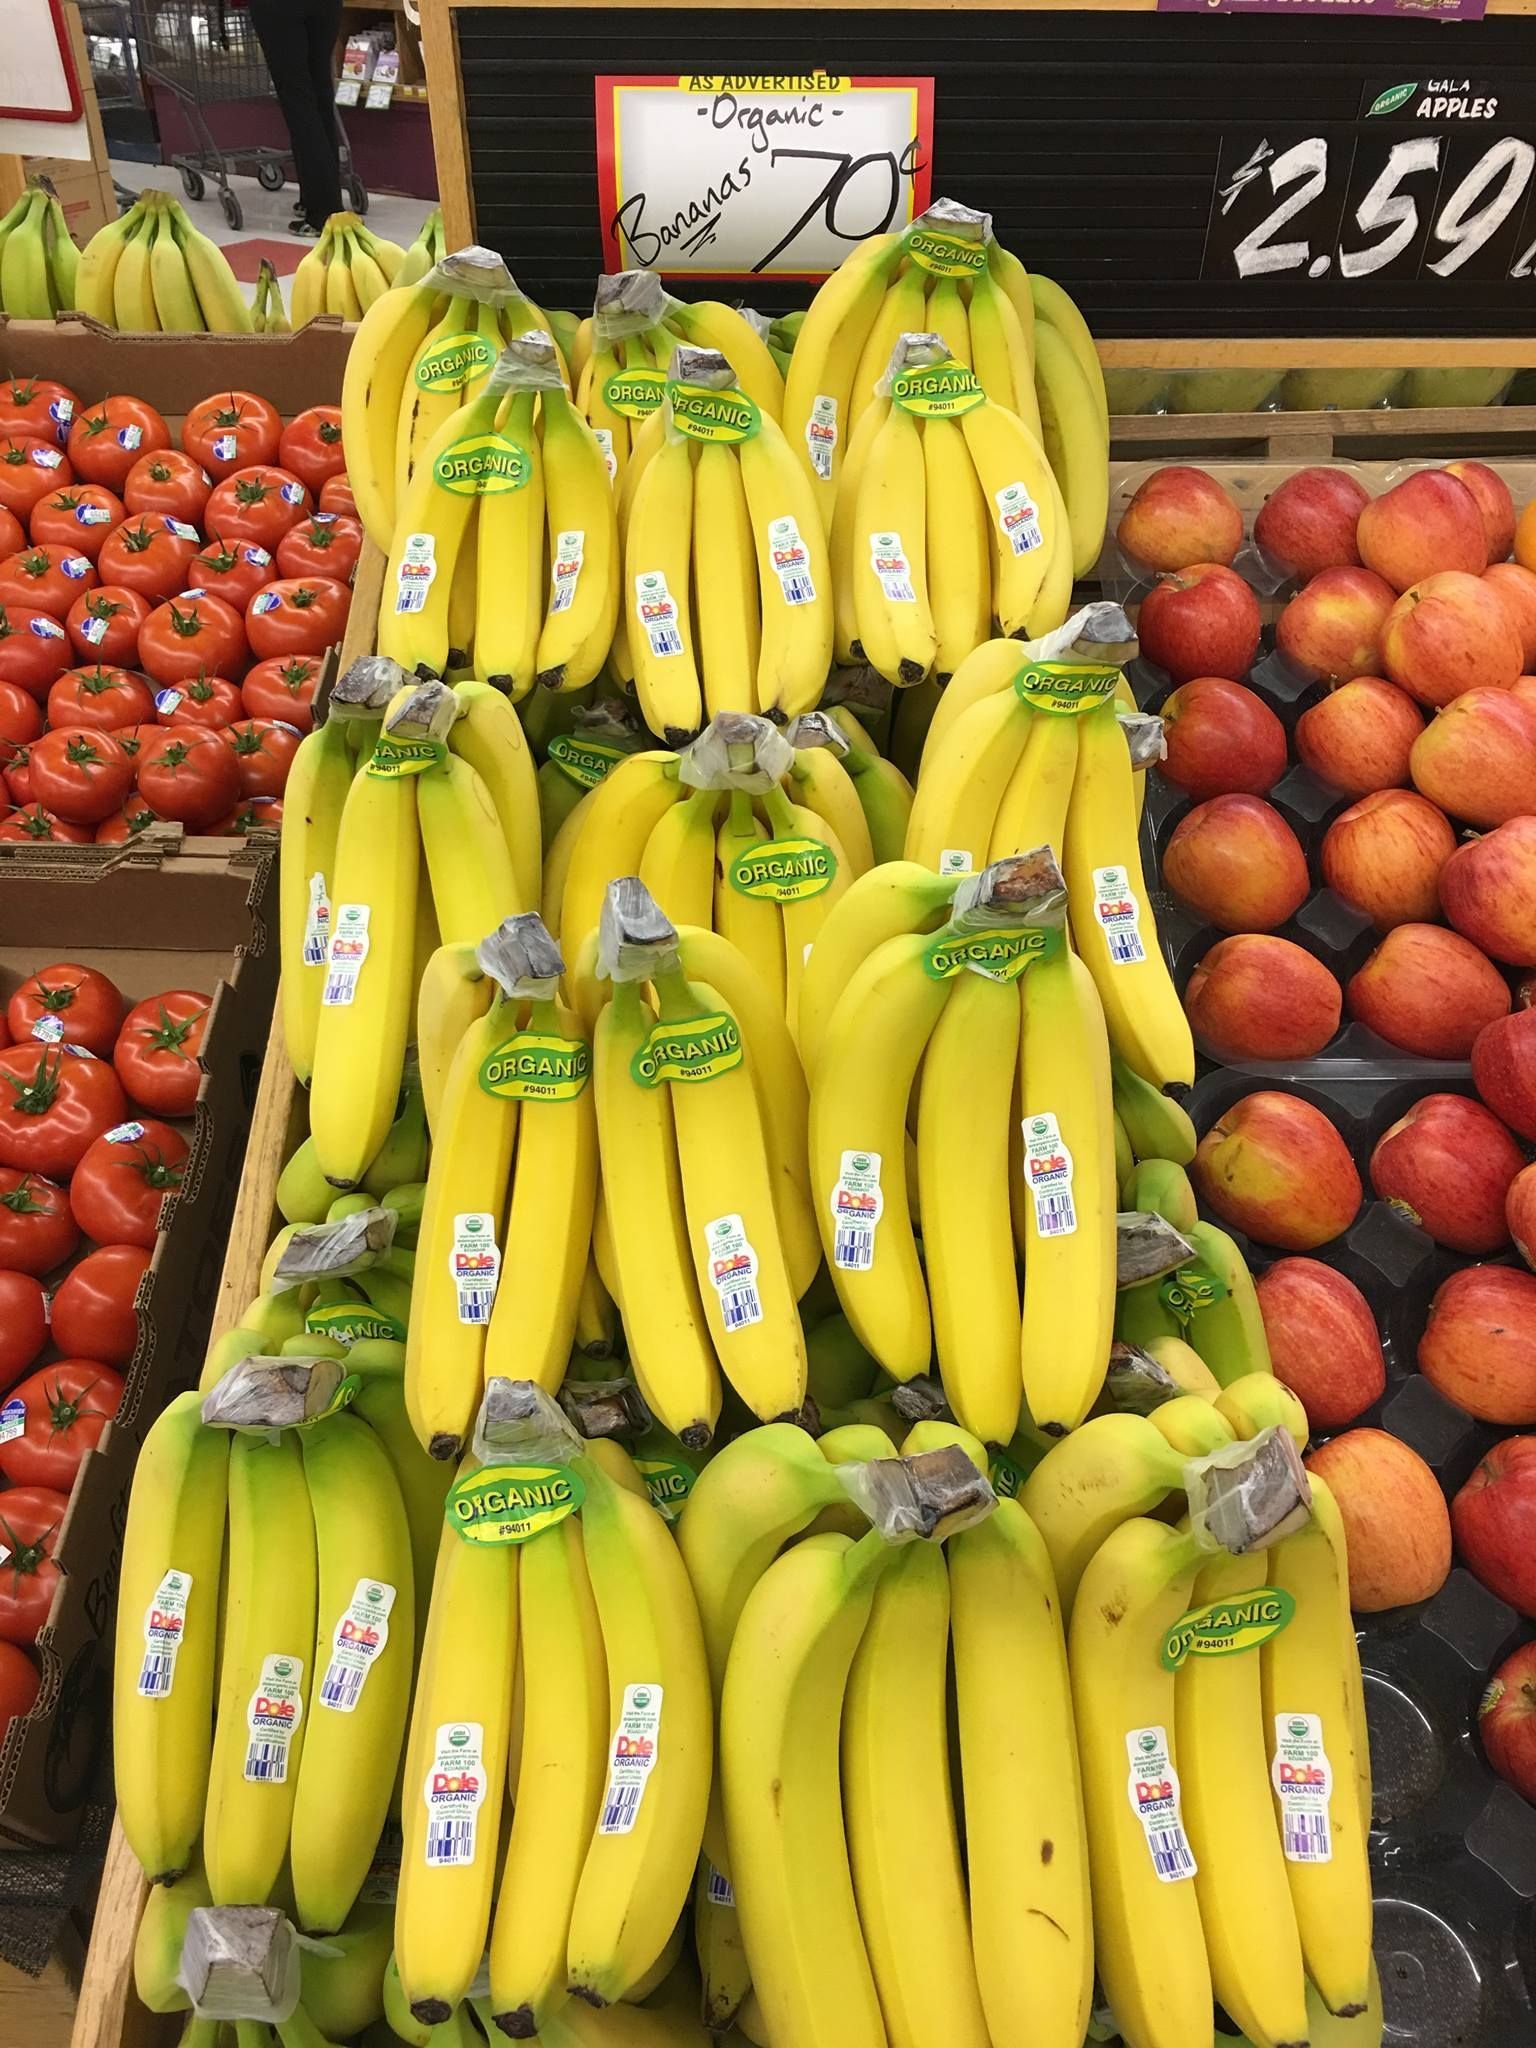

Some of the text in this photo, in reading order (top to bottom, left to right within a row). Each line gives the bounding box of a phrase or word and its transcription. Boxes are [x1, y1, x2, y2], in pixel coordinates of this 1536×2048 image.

[688, 75, 841, 90] AS ADVERTISED
[1427, 79, 1471, 93] GALA
[1373, 87, 1409, 113] ORGANIC
[1416, 97, 1499, 120] APPLES
[610, 156, 751, 267] Bananas
[908, 234, 985, 268] ORGANIC
[928, 262, 952, 274] #94011
[418, 345, 488, 382] ORGANIC
[608, 385, 665, 402] ORGAN
[893, 375, 983, 398] ORGANIC
[670, 387, 753, 429] ORGANIC
[928, 401, 955, 412] #94011
[686, 423, 715, 436] #94011
[438, 454, 524, 480] ORGANIC
[1003, 507, 1035, 528] Dole
[773, 547, 804, 563] Dole
[641, 602, 672, 616] Dole
[1022, 671, 1119, 694] ORGANIC
[1050, 700, 1079, 711] #94011
[555, 743, 613, 774] ORGA
[368, 763, 402, 774] #94011
[736, 855, 829, 885] ORGANIC
[1098, 900, 1133, 916] Dole
[1102, 914, 1135, 924] ORGANIC
[333, 938, 364, 954] Dole
[931, 932, 1046, 972] ORGANIC
[331, 954, 361, 962] ORGANIC
[638, 1025, 739, 1079] ORGANIC
[486, 1052, 588, 1082] ORGANIC
[679, 1064, 712, 1079] #94011
[522, 1084, 557, 1096] #94011
[1029, 1154, 1067, 1173] Dole
[1032, 1170, 1068, 1184] ORGANIC
[838, 1190, 877, 1209] Dole
[836, 1208, 876, 1219] ORGANIC
[456, 1253, 495, 1268] Dole
[713, 1254, 751, 1277] Dole
[456, 1269, 495, 1278] ORGANIC
[716, 1267, 752, 1285] ORGANIC
[453, 1478, 573, 1521] ORGANIC
[498, 1521, 532, 1536] #94011
[150, 1610, 184, 1631] Dole
[1167, 1600, 1282, 1659] ORGANIC
[340, 1620, 380, 1644] Dole
[337, 1639, 375, 1656] ORGANIC
[1196, 1637, 1235, 1649] #94011
[255, 1697, 295, 1716] Dole
[252, 1717, 293, 1730] ORGANIC
[616, 1736, 654, 1756] Dole
[613, 1757, 650, 1767] ORGANIC
[432, 1772, 480, 1792] Dole
[1279, 1762, 1326, 1784] Dole
[431, 1793, 477, 1803] ORGANIC
[1135, 1778, 1174, 1800] Dole
[1280, 1785, 1326, 1795] ORGANIC
